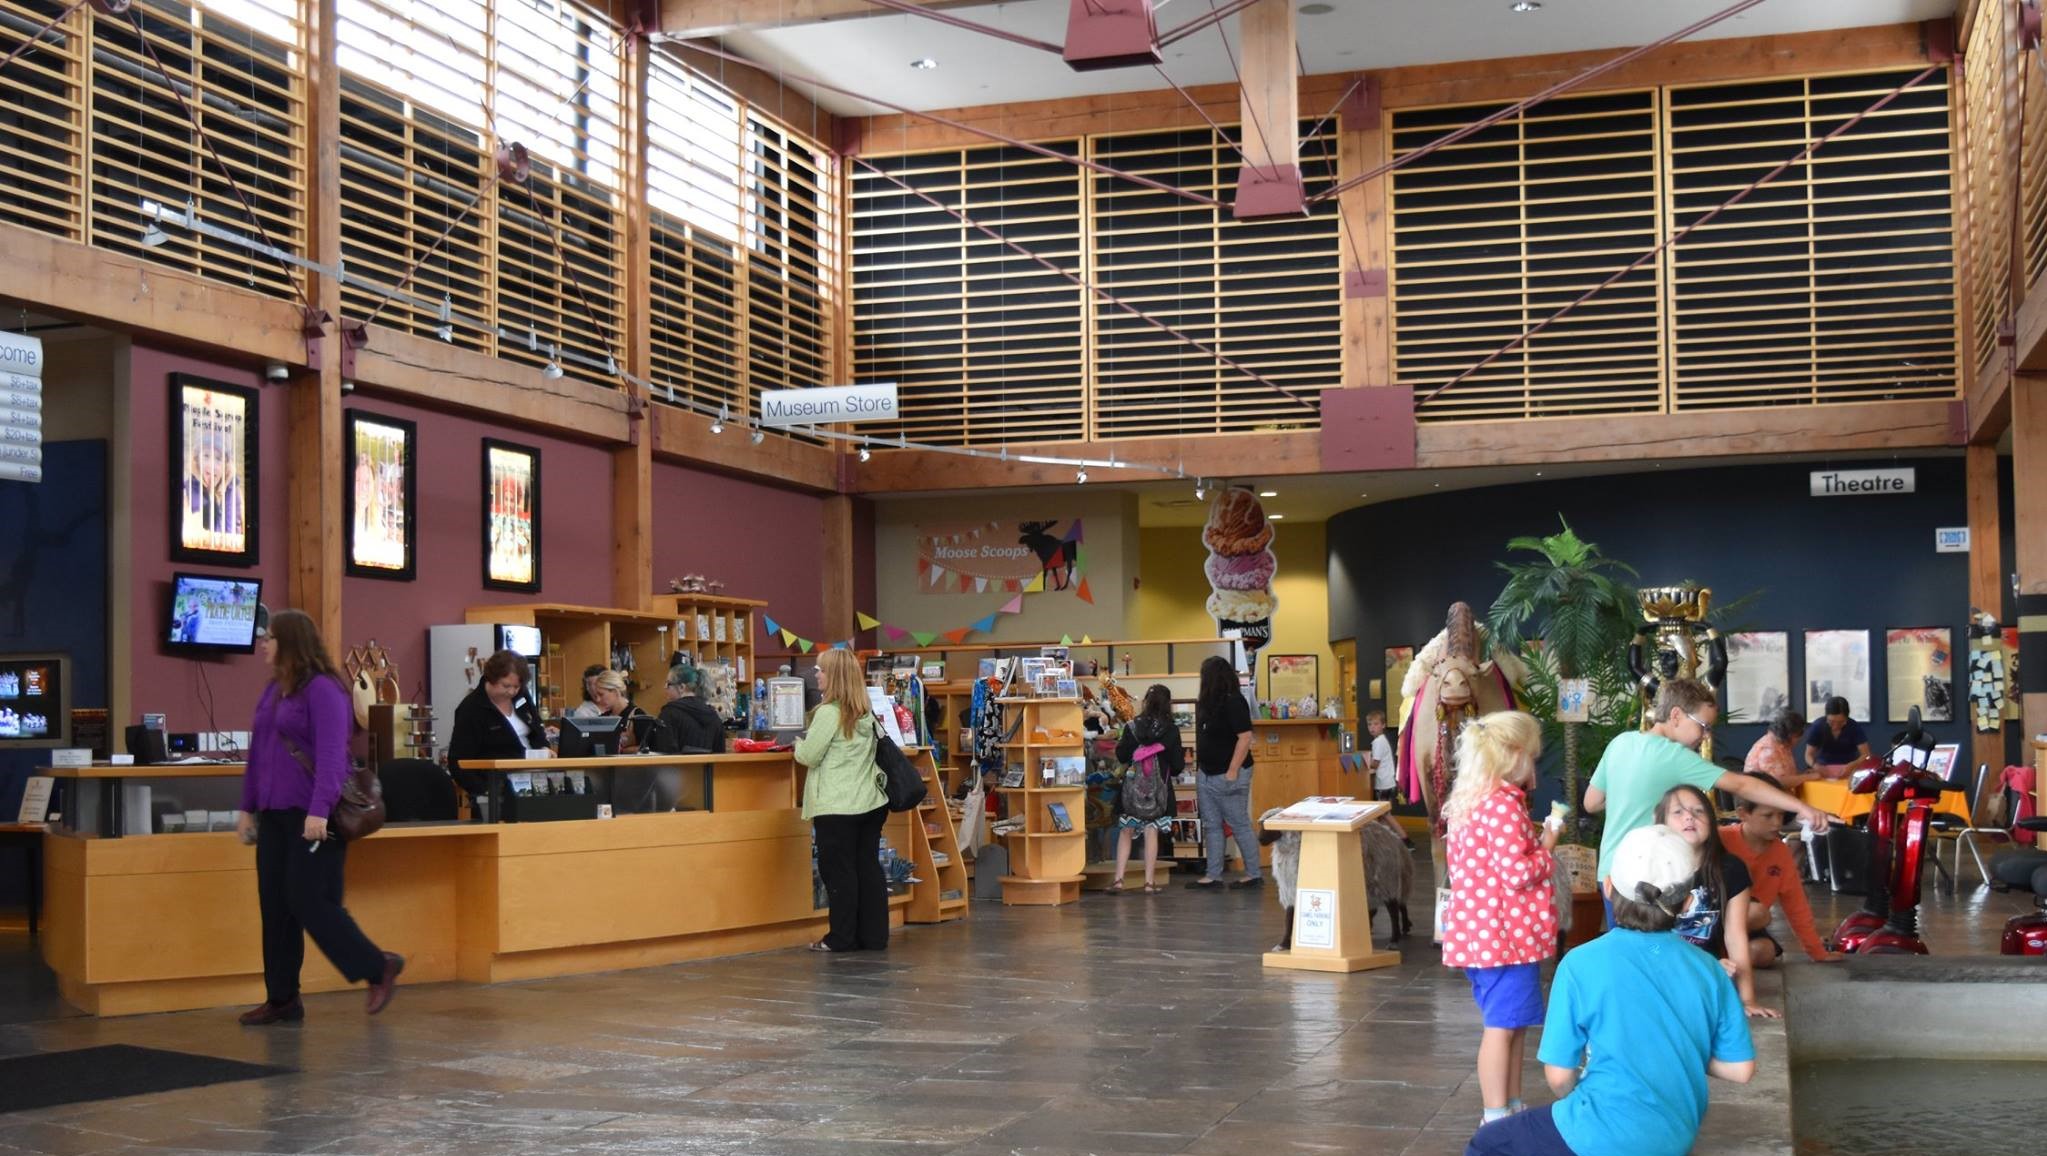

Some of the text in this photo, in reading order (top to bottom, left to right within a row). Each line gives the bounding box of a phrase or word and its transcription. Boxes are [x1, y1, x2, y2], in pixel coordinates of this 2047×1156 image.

[766, 395, 892, 418] Museum Store
[1821, 472, 1905, 493] Theatre
[934, 545, 1029, 561] Moose Scoops
[1222, 625, 1269, 639] PMAN'S
